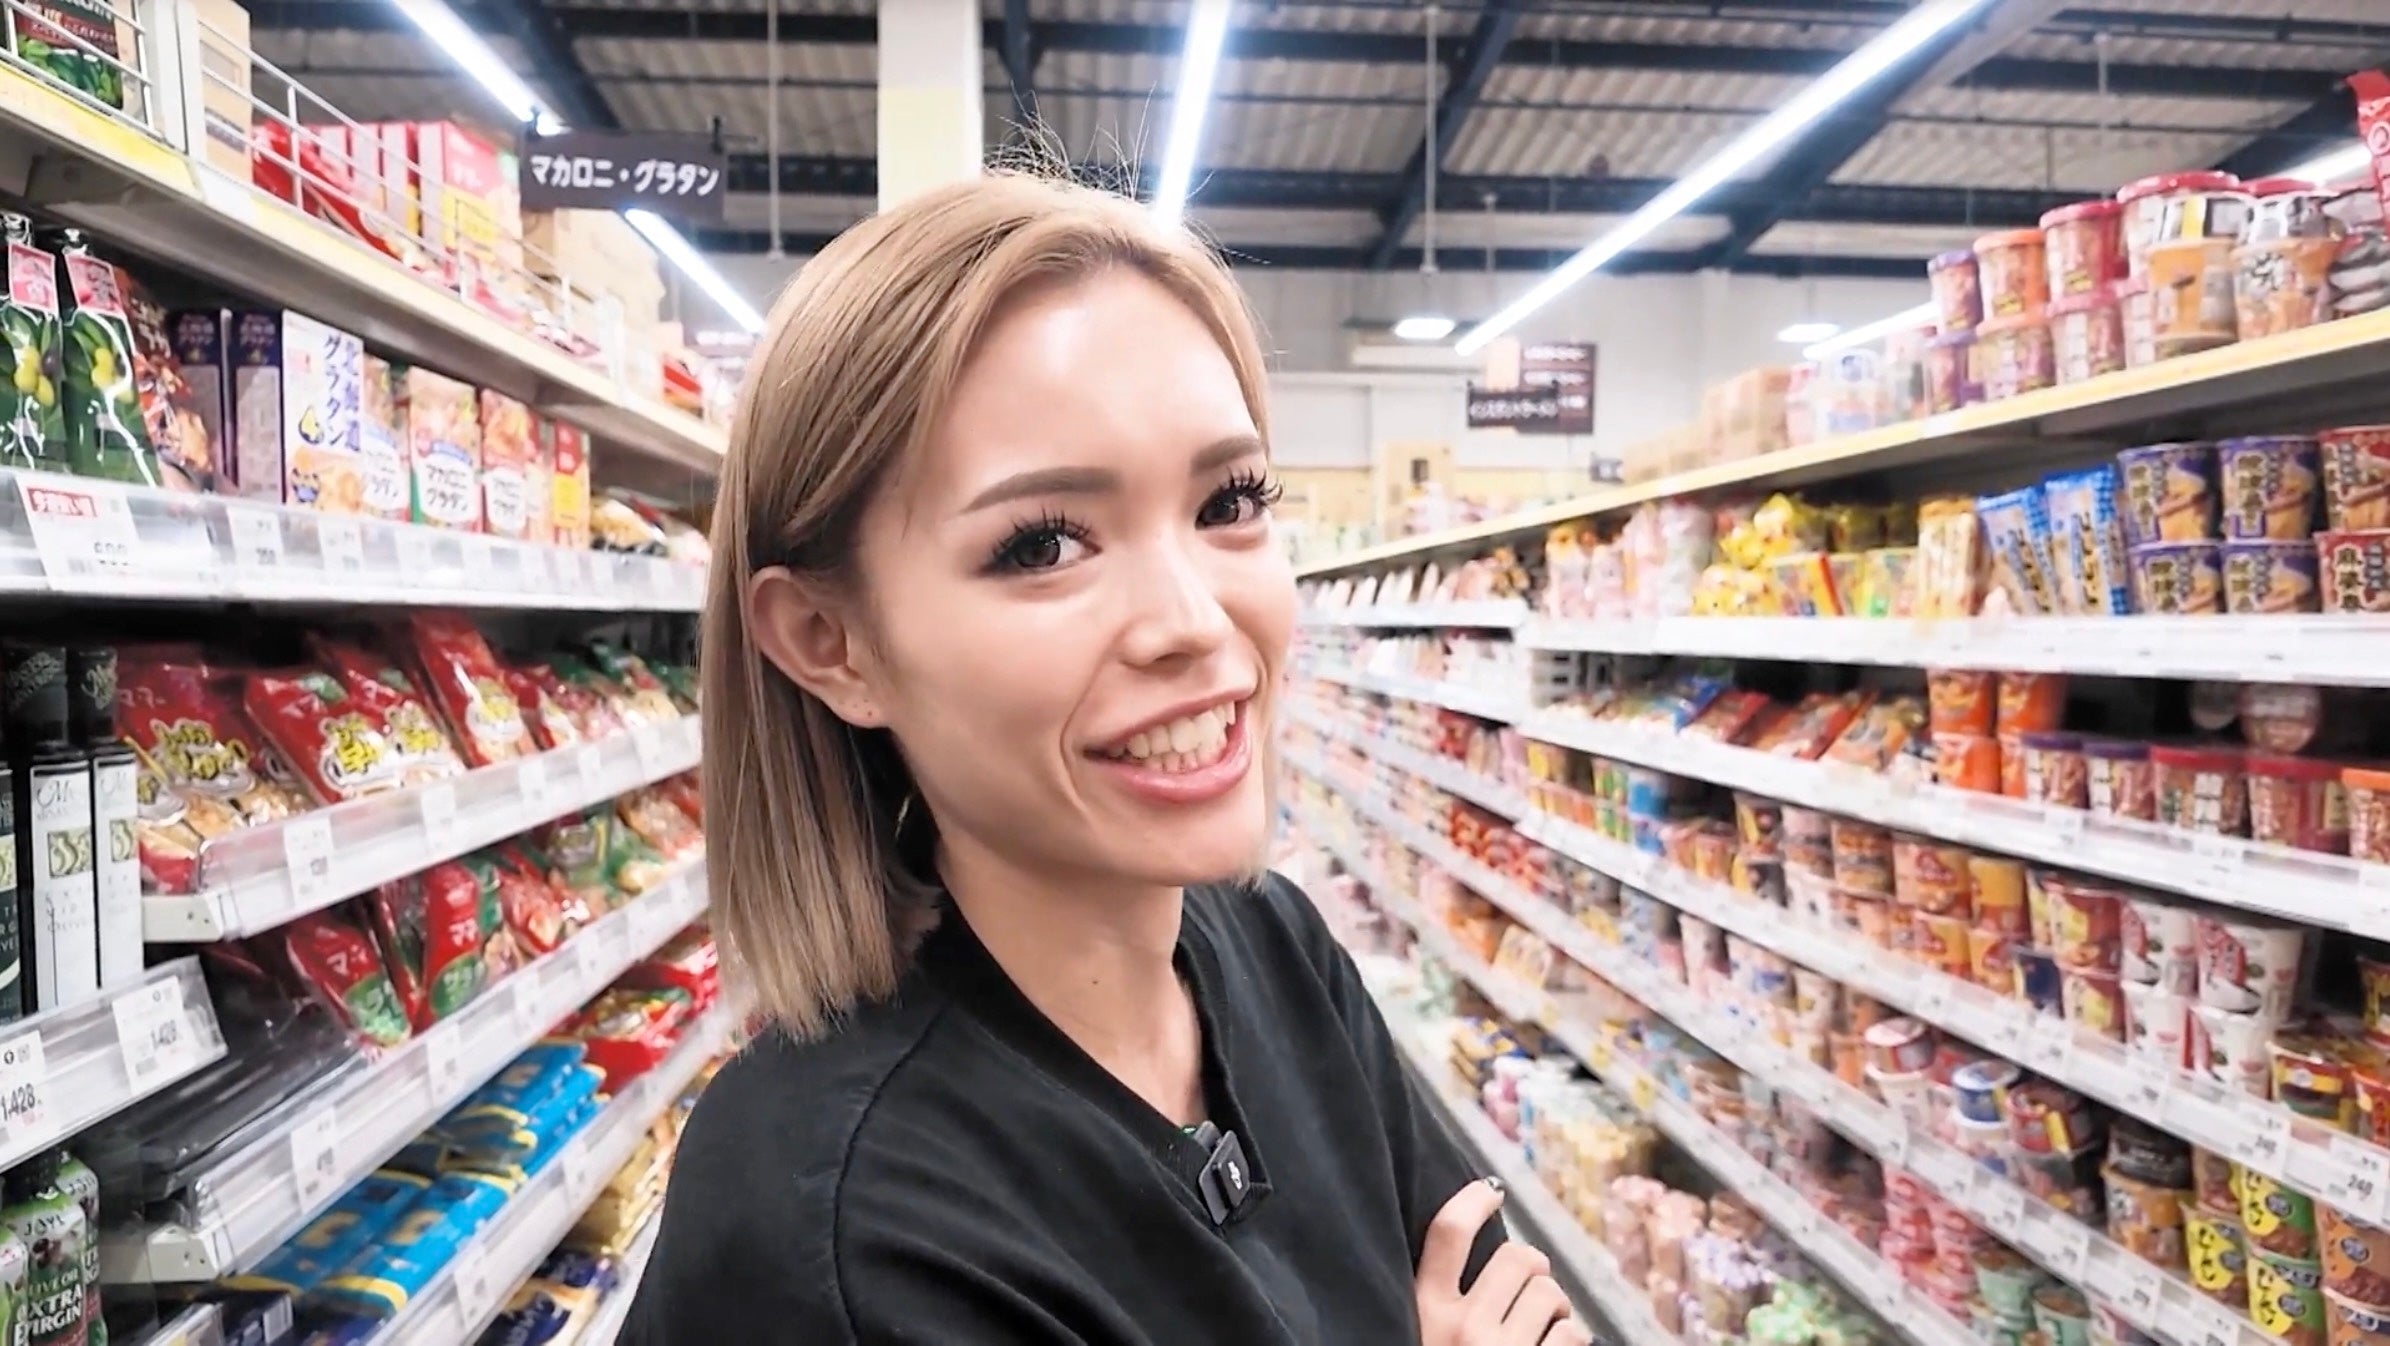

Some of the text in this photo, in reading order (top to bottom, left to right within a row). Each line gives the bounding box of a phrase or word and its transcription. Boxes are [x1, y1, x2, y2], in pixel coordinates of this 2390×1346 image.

[529, 153, 720, 197] マカロニ・グラタン
